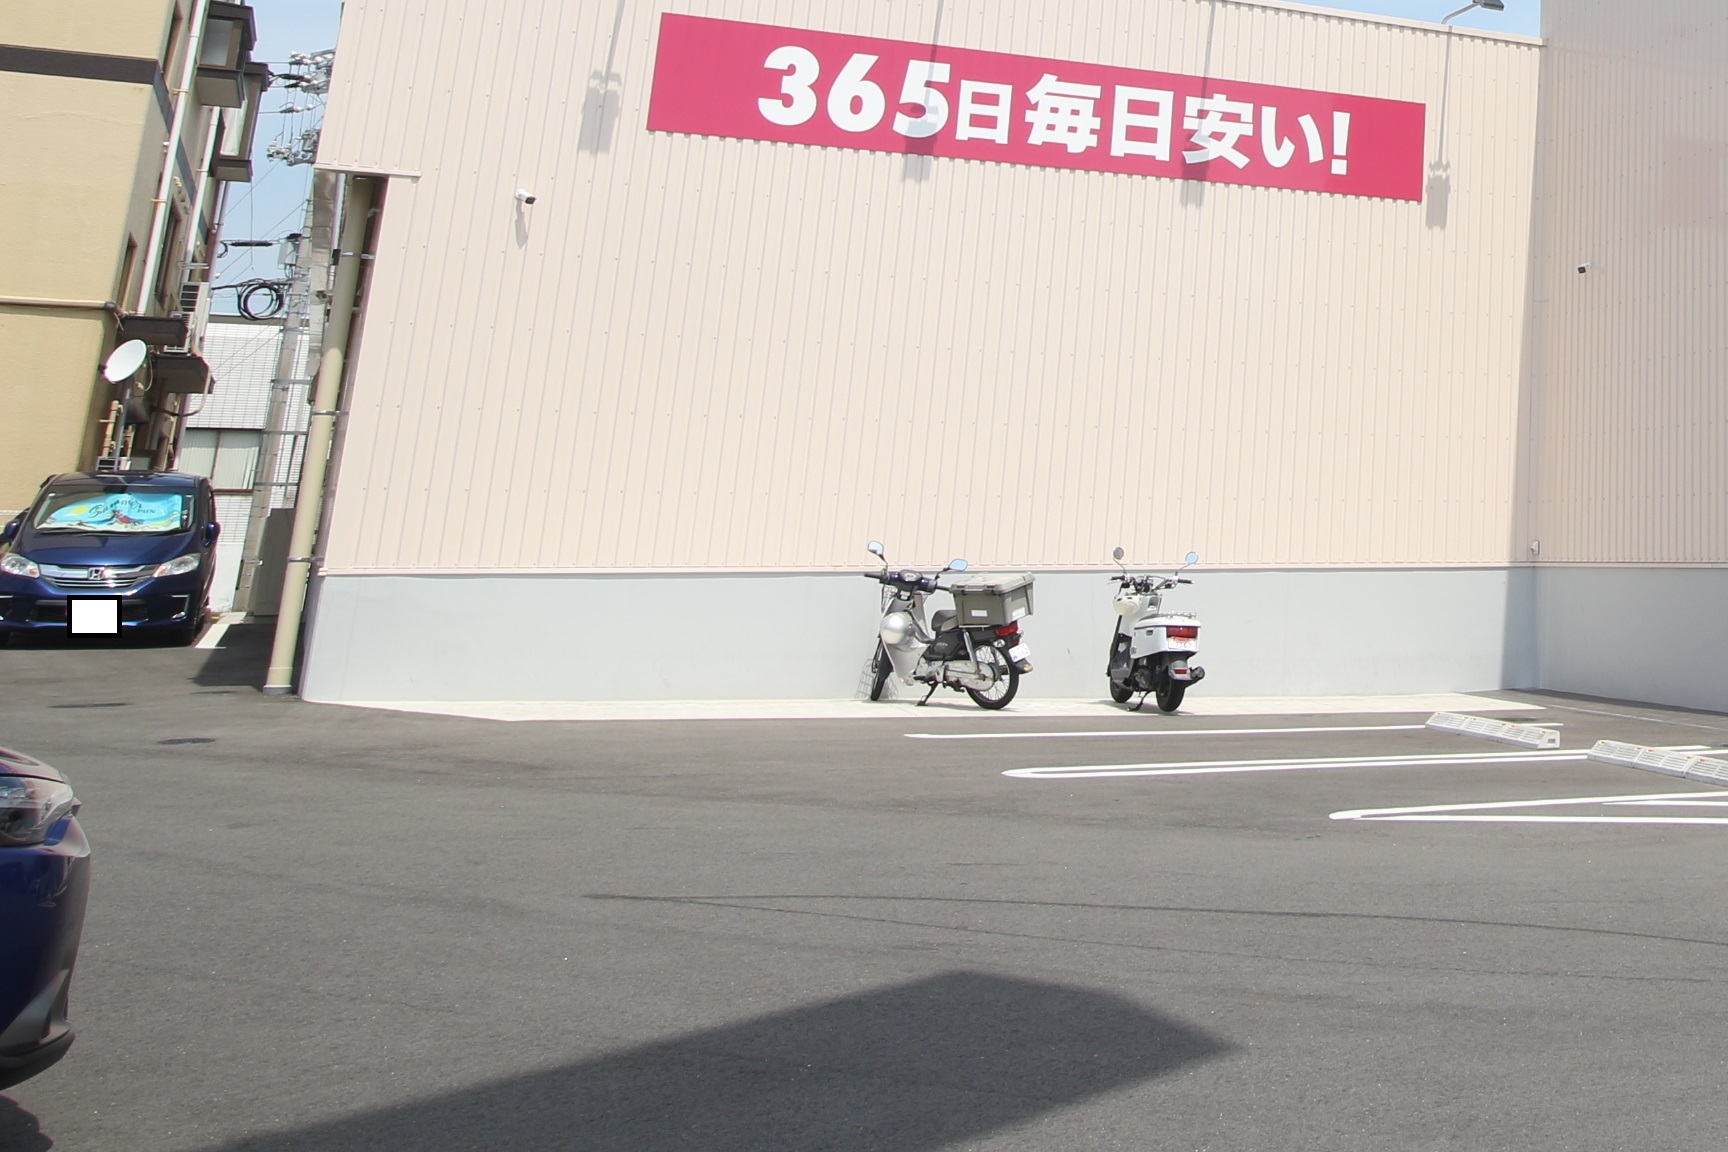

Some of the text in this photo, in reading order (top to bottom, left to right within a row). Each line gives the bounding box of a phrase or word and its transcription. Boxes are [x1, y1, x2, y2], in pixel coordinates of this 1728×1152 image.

[756, 44, 1351, 176] 365日毎日安い!
